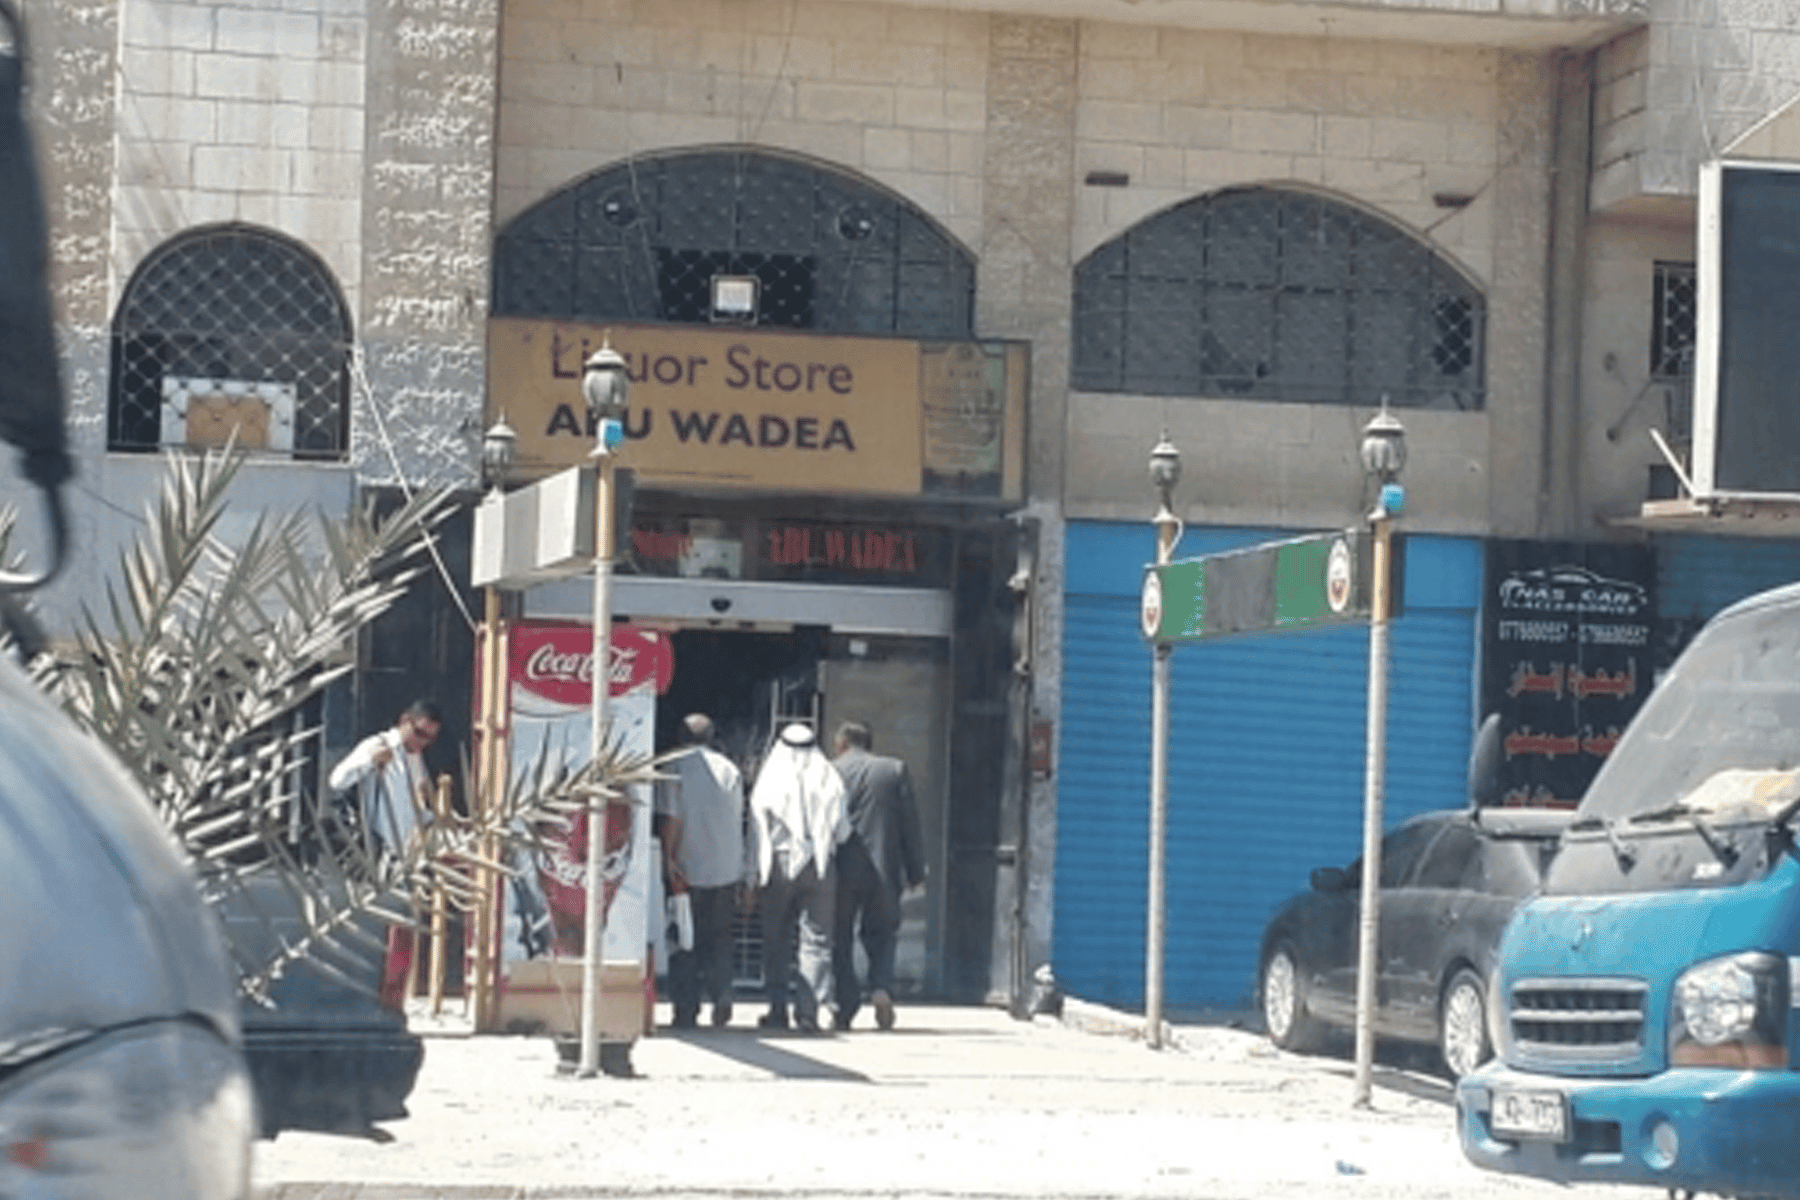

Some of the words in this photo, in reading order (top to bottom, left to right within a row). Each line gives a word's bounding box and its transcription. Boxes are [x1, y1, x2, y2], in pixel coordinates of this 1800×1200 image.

[552, 332, 708, 386] Liuor
[726, 345, 854, 394] Store
[670, 409, 856, 452] WADEA
